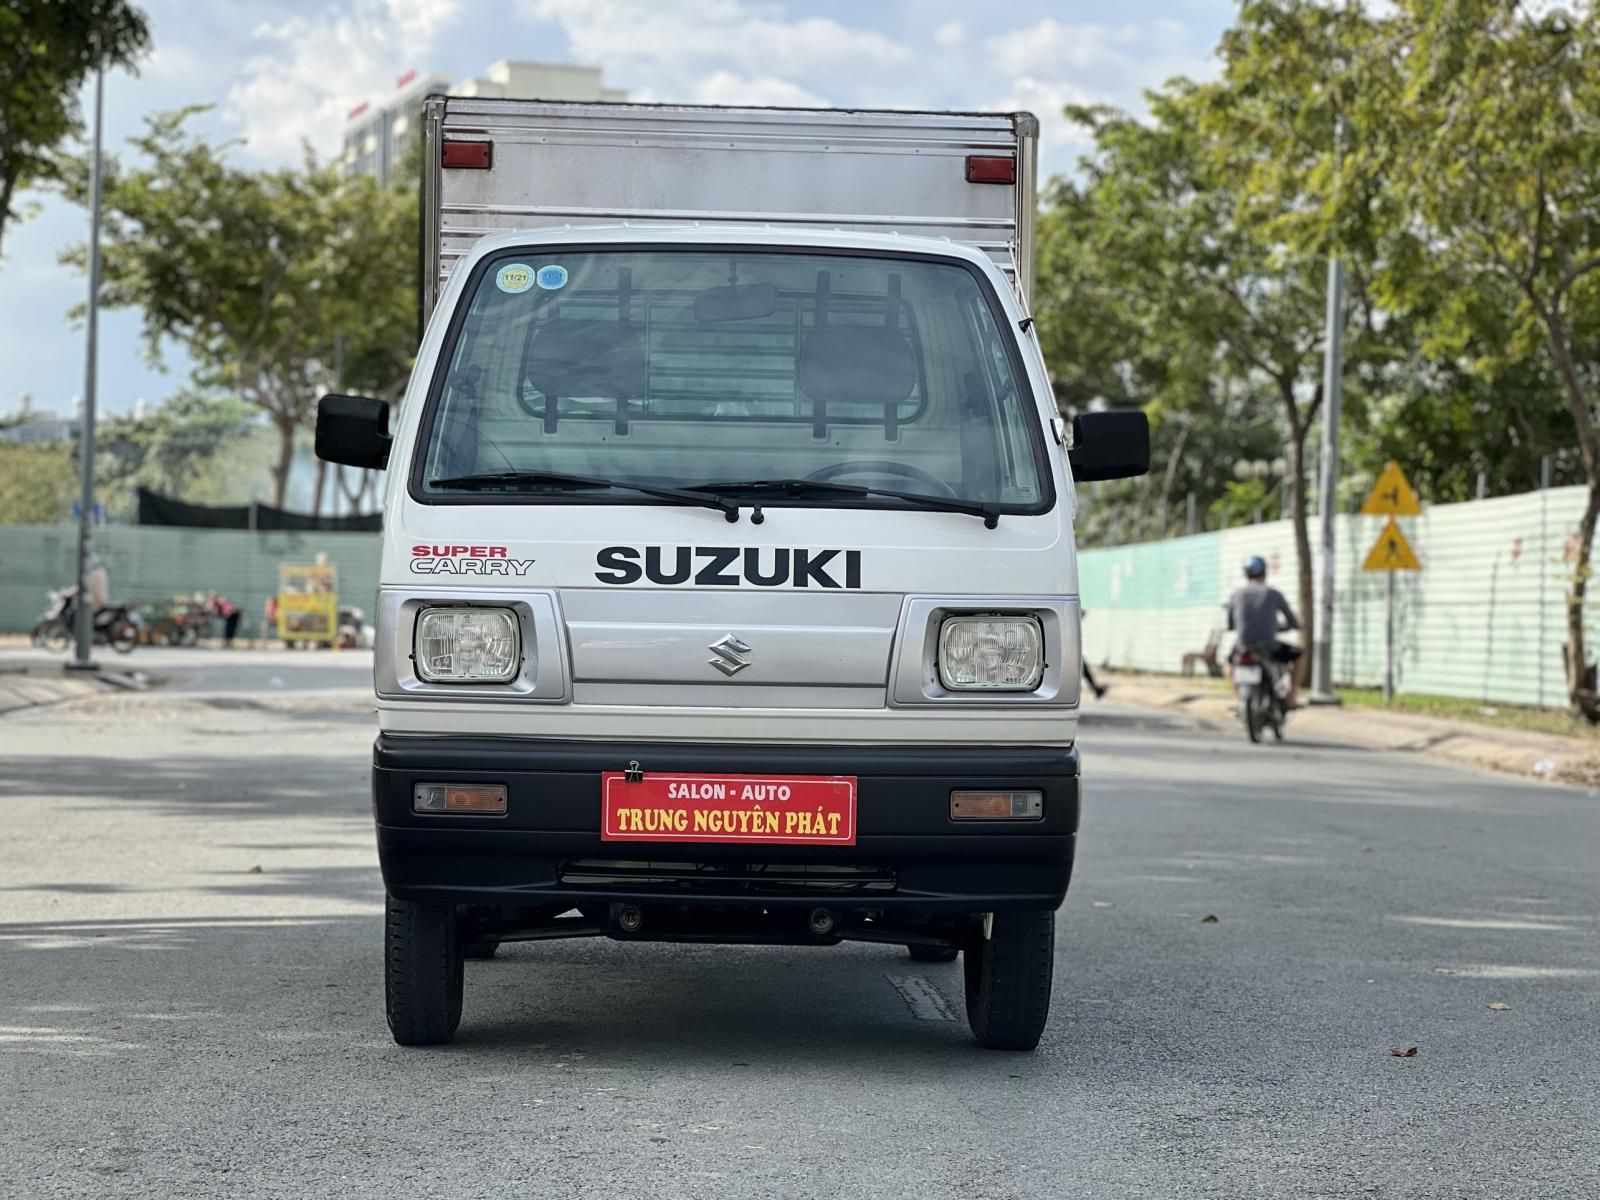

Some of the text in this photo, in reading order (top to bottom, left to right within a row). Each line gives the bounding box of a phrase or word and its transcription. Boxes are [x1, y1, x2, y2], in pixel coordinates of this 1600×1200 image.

[411, 545, 508, 558] SUPER
[409, 558, 536, 576] CARRY
[594, 546, 862, 589] SUZUKI
[667, 783, 726, 800] SALON
[741, 785, 791, 801] AUTO
[617, 804, 841, 835] TRUNG NGUYÊN PHÁT
